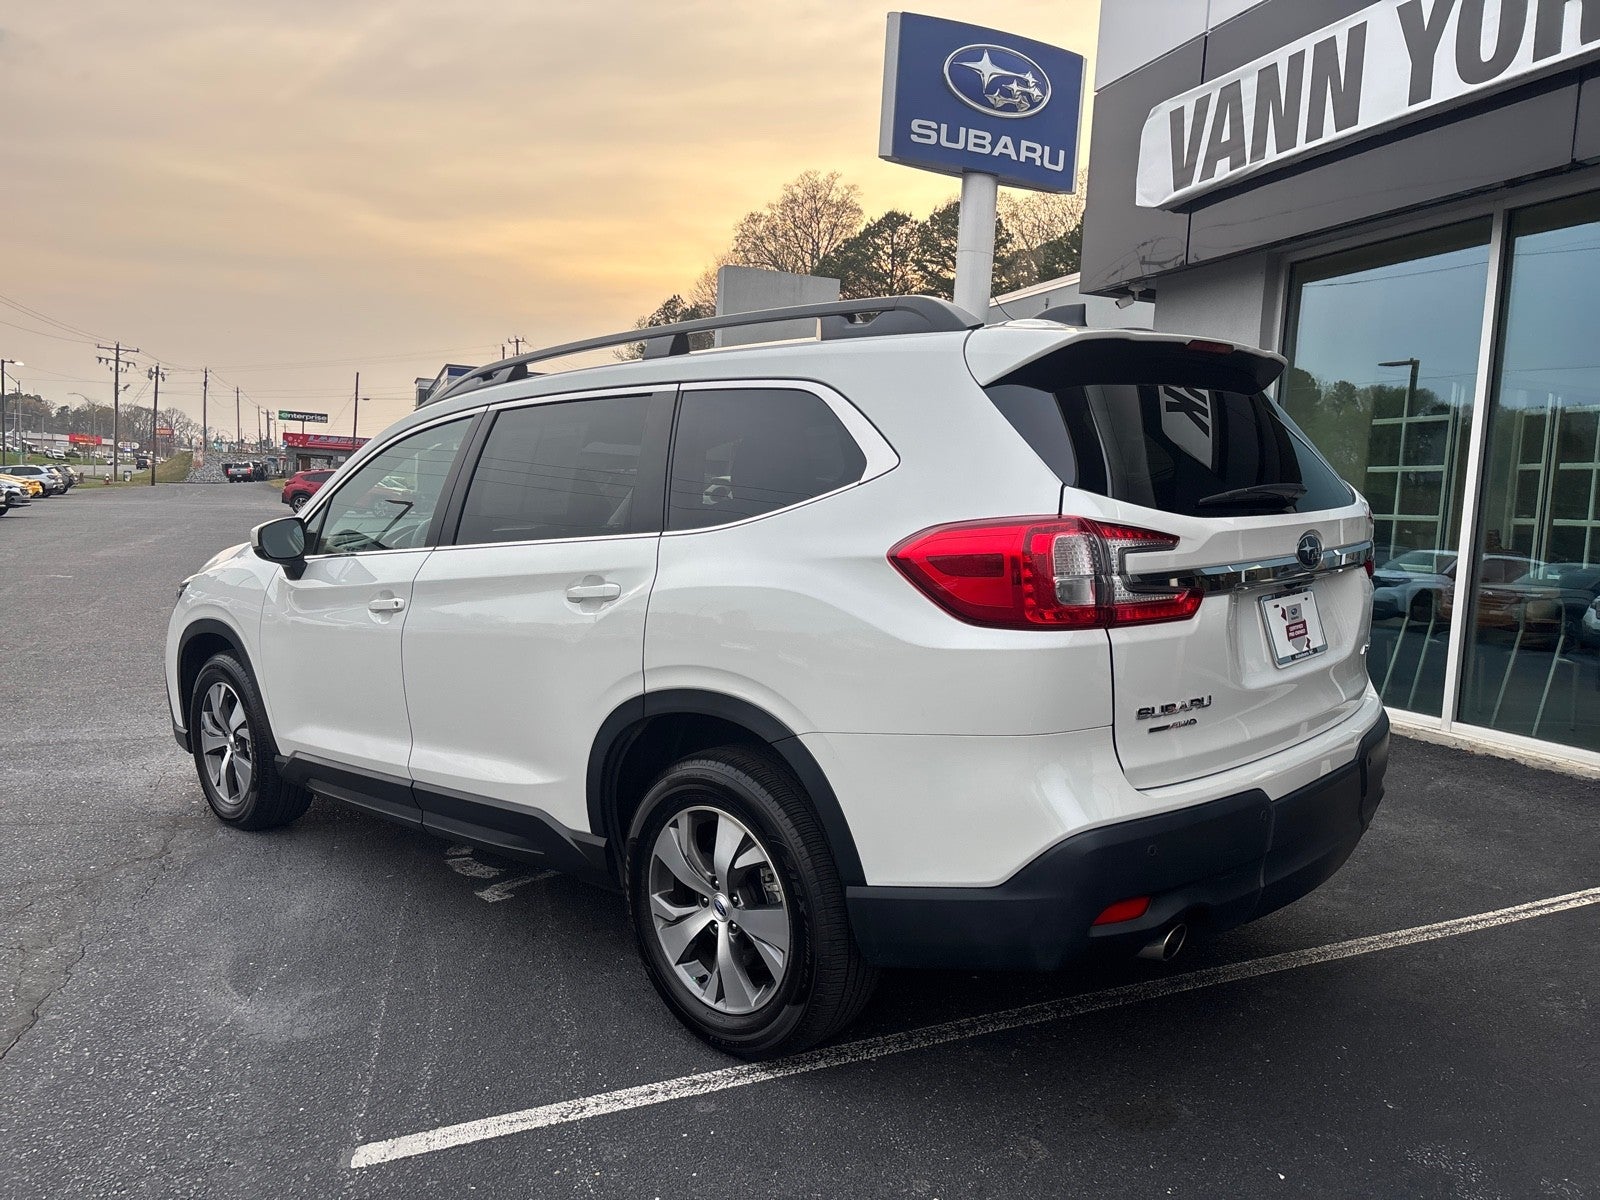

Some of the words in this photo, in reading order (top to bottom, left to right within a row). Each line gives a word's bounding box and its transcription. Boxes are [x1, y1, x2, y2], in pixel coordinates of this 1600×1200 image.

[1169, 20, 1368, 193] VANN
[910, 118, 1065, 172] SUBARU
[279, 411, 328, 422] enterprise
[1136, 694, 1212, 720] SUBARU
